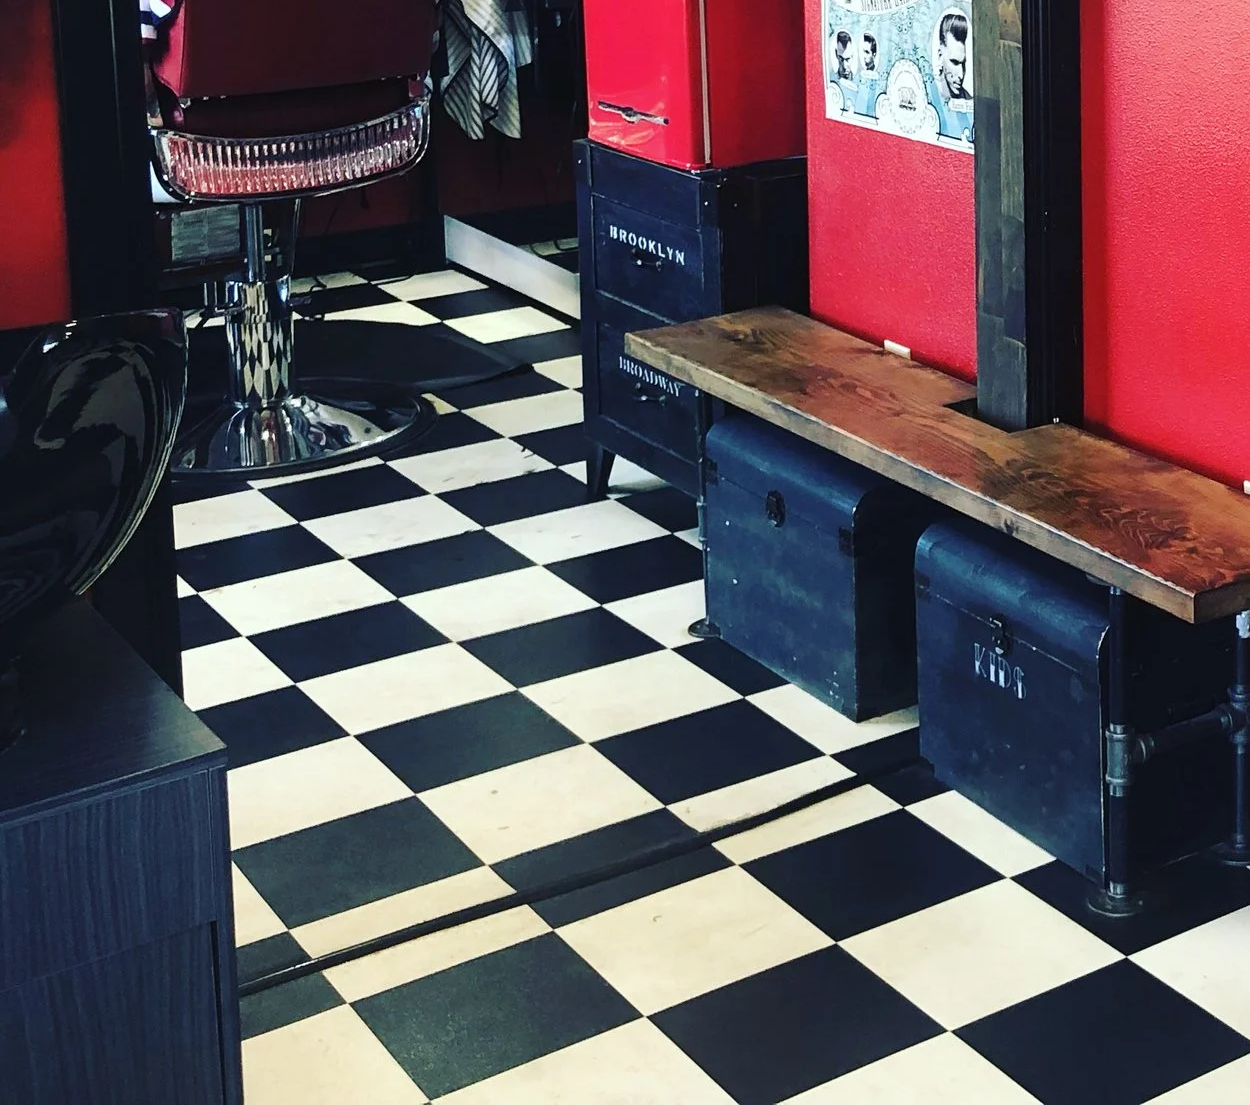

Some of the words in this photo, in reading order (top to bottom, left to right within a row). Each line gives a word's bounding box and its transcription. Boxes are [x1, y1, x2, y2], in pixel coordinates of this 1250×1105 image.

[609, 225, 685, 266] BROOKLYN
[619, 356, 681, 397] BROADWAY
[974, 643, 1027, 699] KIDS
